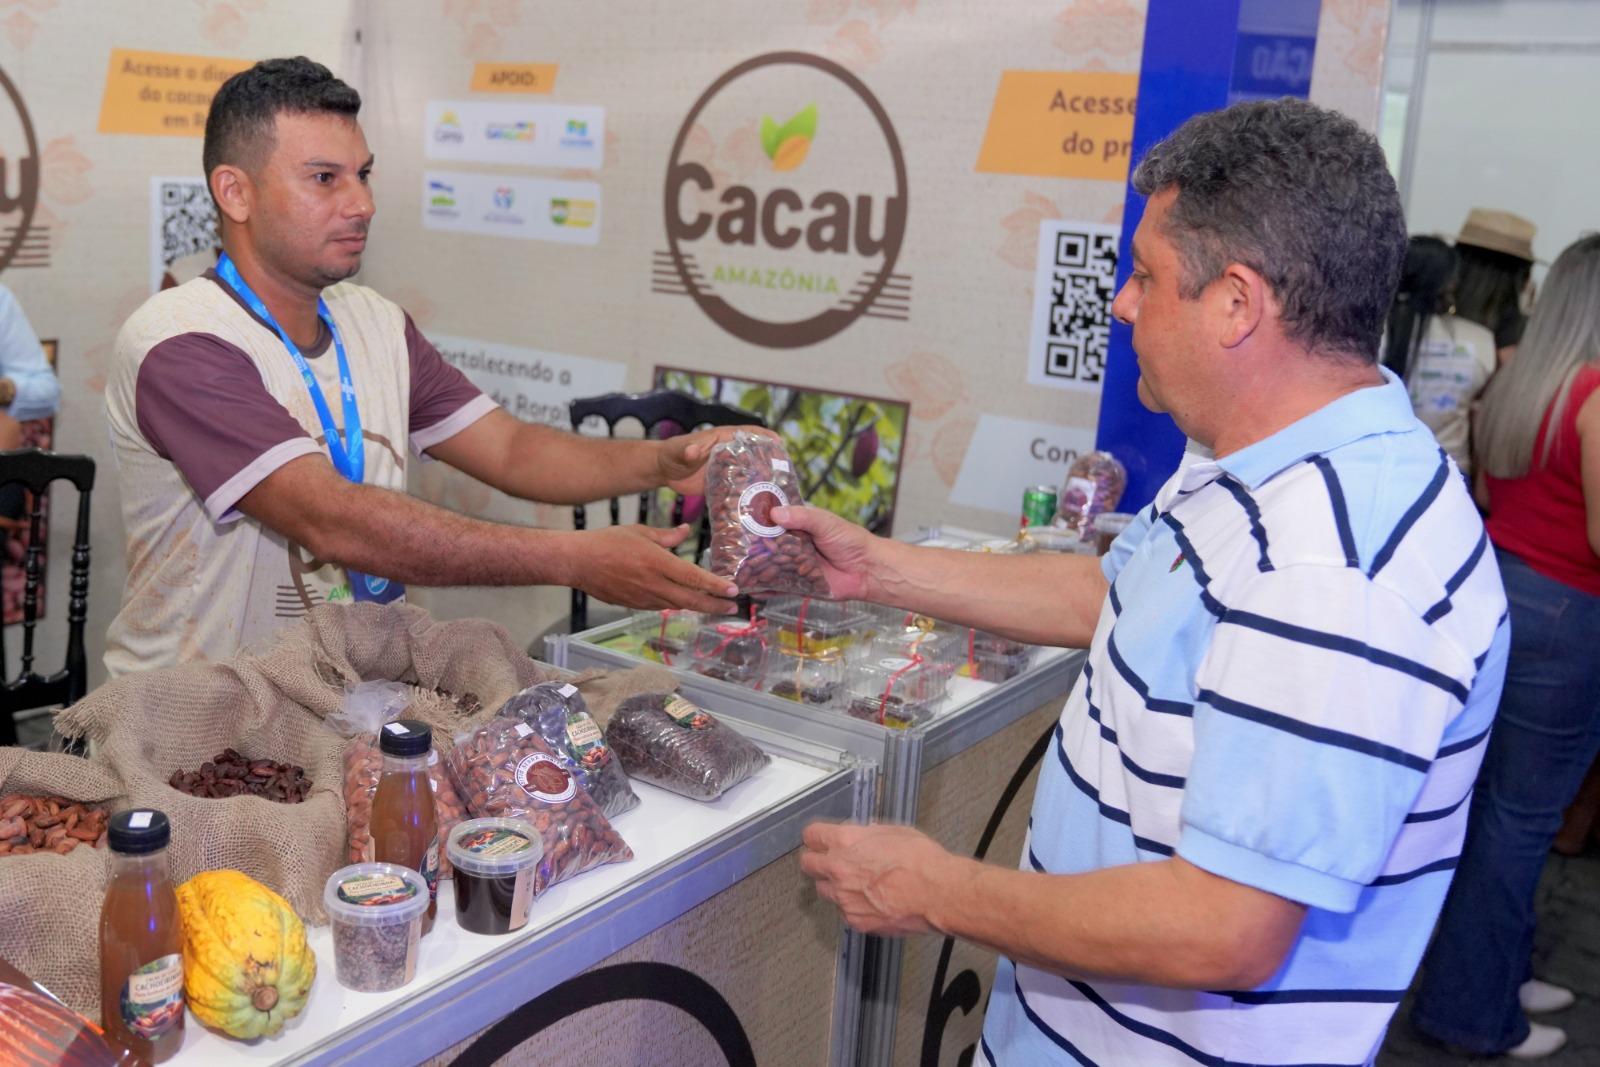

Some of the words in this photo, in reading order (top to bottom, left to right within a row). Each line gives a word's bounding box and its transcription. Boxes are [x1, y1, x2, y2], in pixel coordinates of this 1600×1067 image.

[1049, 89, 1136, 115] Acesse
[1062, 131, 1094, 155] do
[666, 162, 906, 258] Cacau
[713, 264, 841, 294] AMAZÔNIA
[1030, 437, 1077, 463] Con
